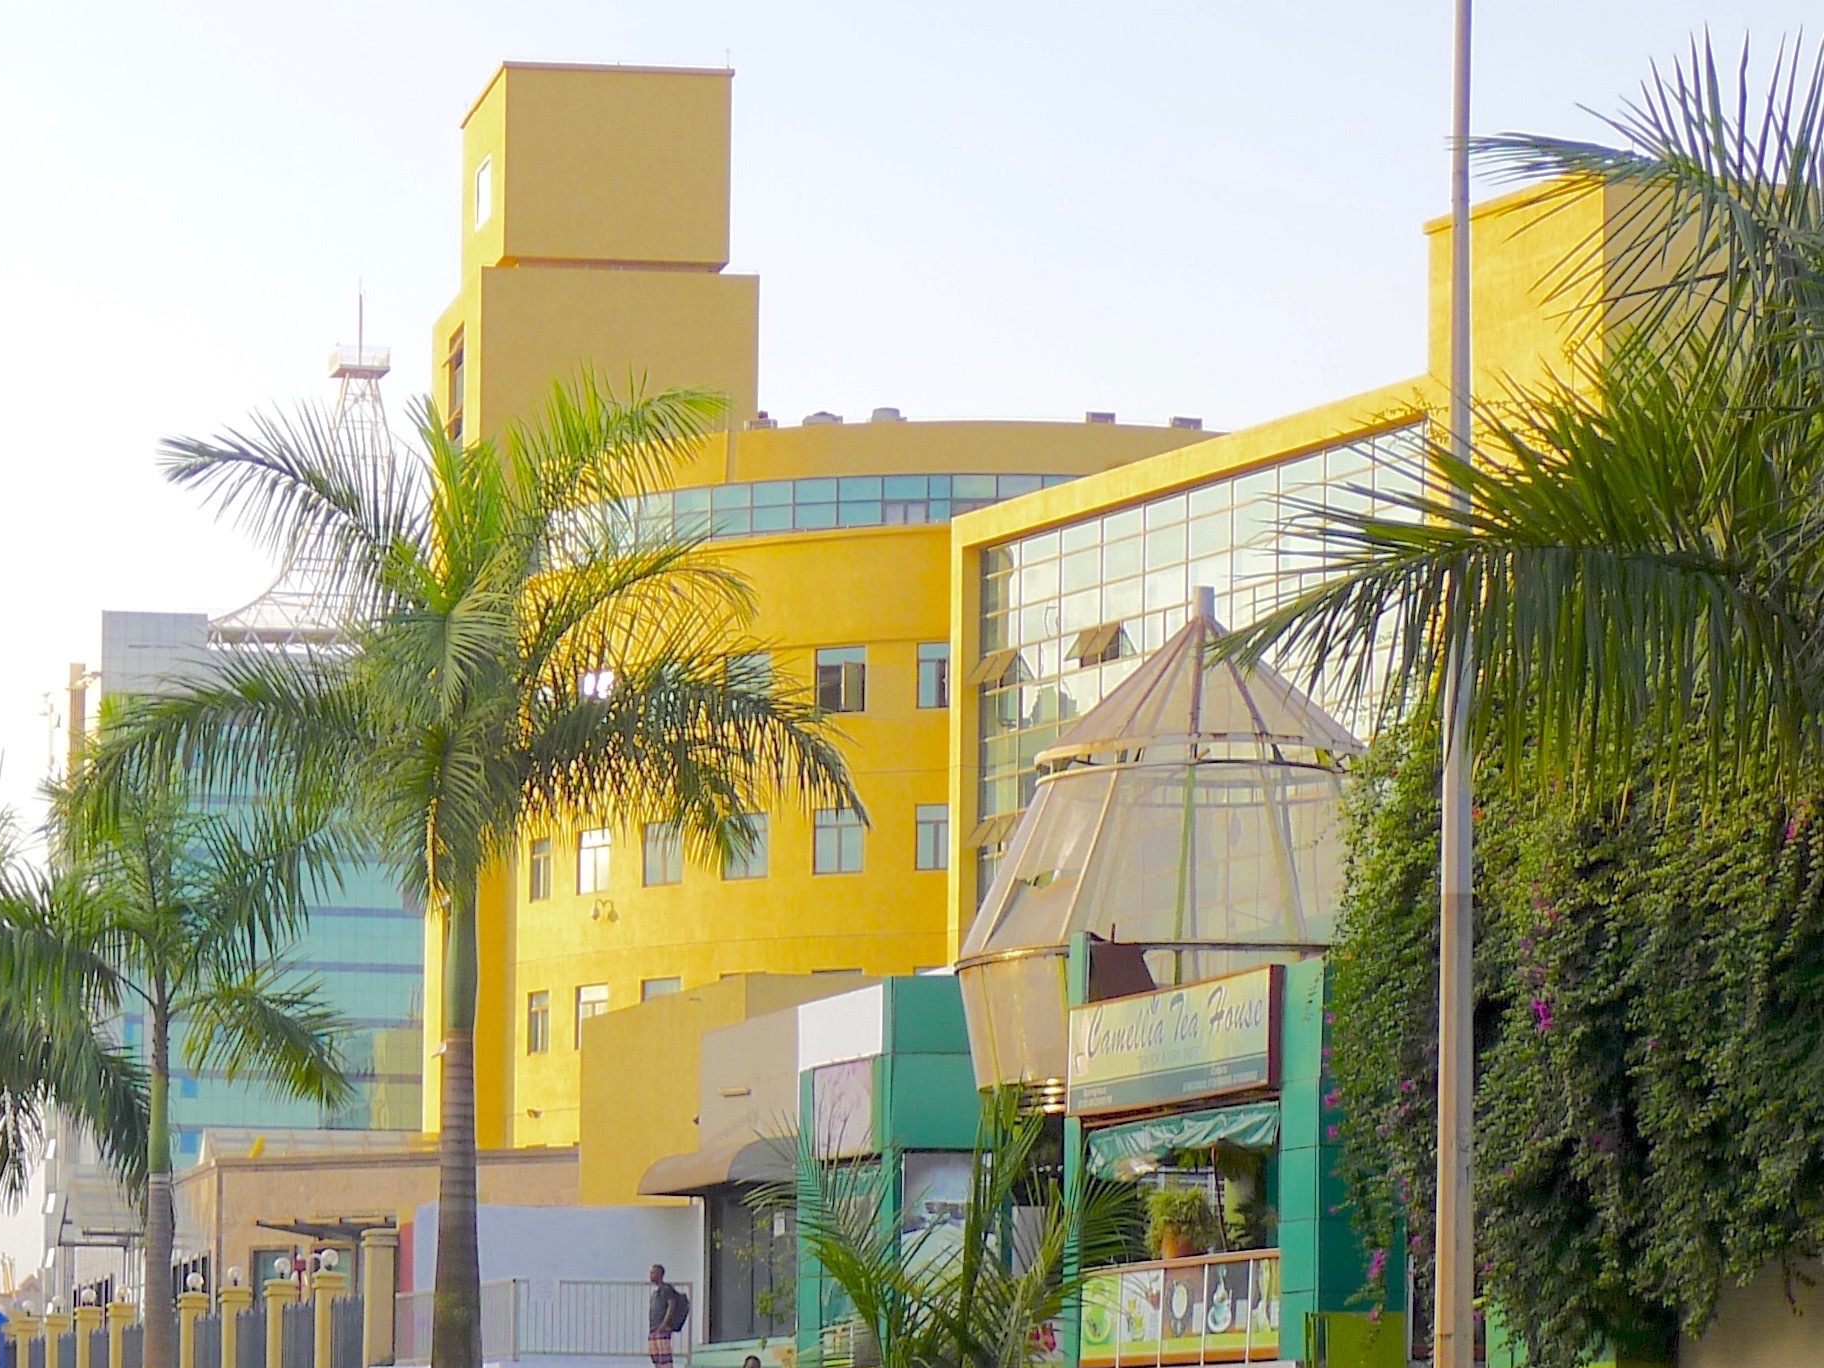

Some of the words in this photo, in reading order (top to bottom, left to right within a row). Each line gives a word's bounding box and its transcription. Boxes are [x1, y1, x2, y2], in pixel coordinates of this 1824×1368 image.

[1087, 1000, 1164, 1058] Camellia
[1169, 991, 1199, 1043] Tea
[1207, 985, 1263, 1034] House
